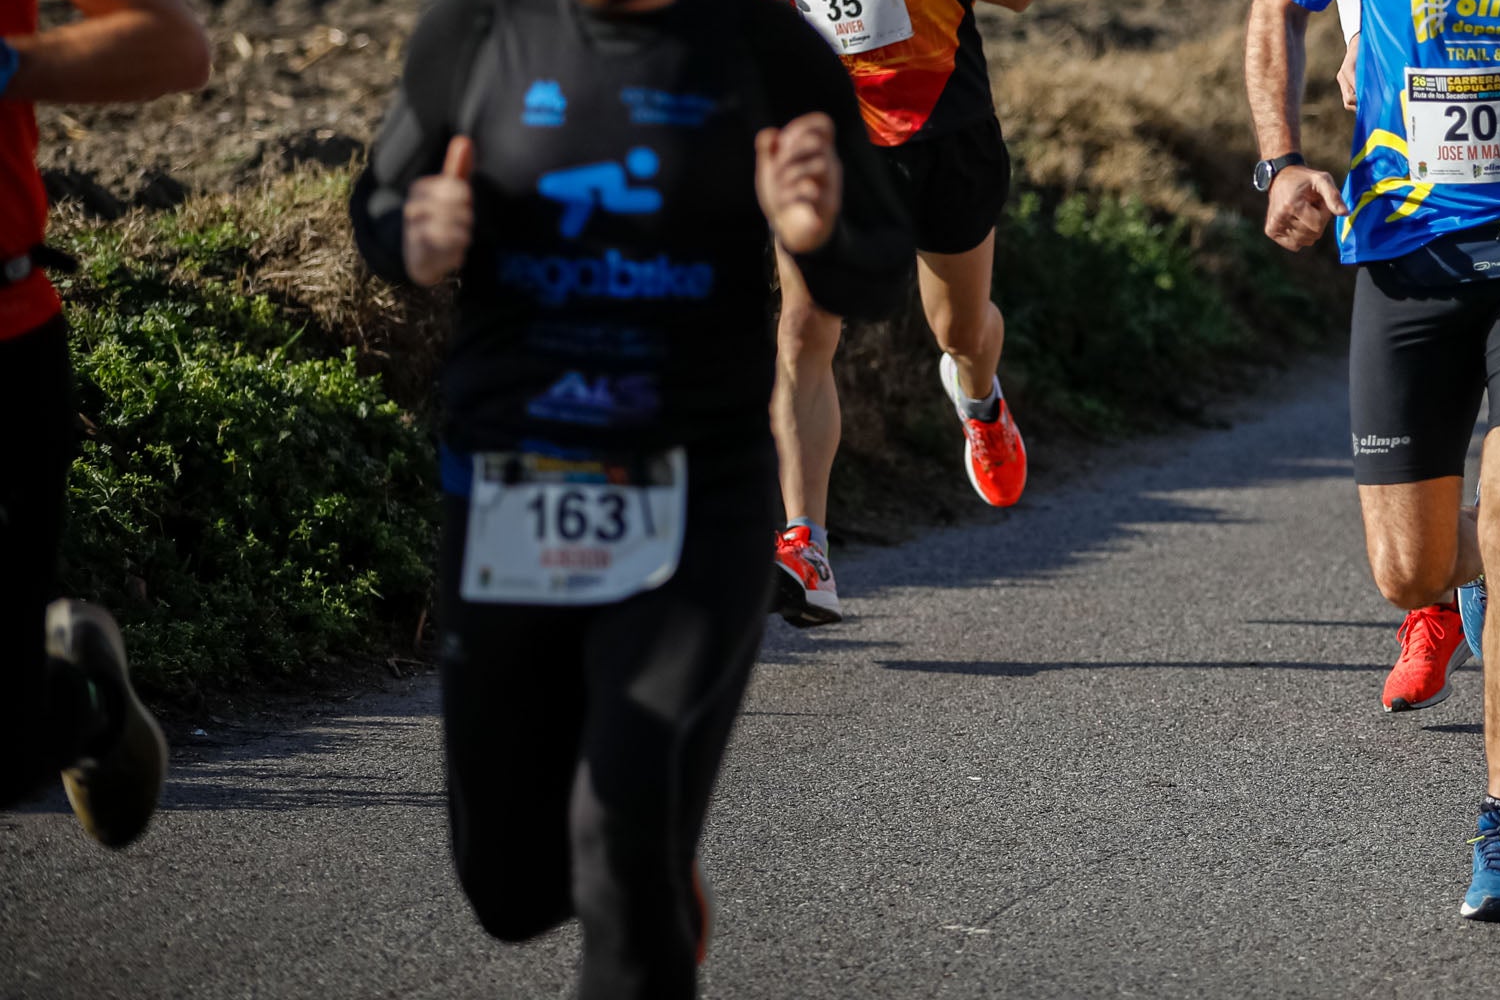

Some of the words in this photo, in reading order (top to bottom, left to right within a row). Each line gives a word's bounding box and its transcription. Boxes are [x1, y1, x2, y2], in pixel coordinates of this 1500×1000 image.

[835, 20, 865, 36] JAVIER
[1446, 47, 1490, 61] TRAIL
[1412, 76, 1426, 87] 26
[1435, 76, 1447, 92] VII
[1447, 75, 1500, 85] CARRERA
[1437, 145, 1464, 160] JOSE
[1467, 145, 1478, 160] M
[1361, 435, 1410, 448] olimpo
[528, 491, 626, 543] 163
